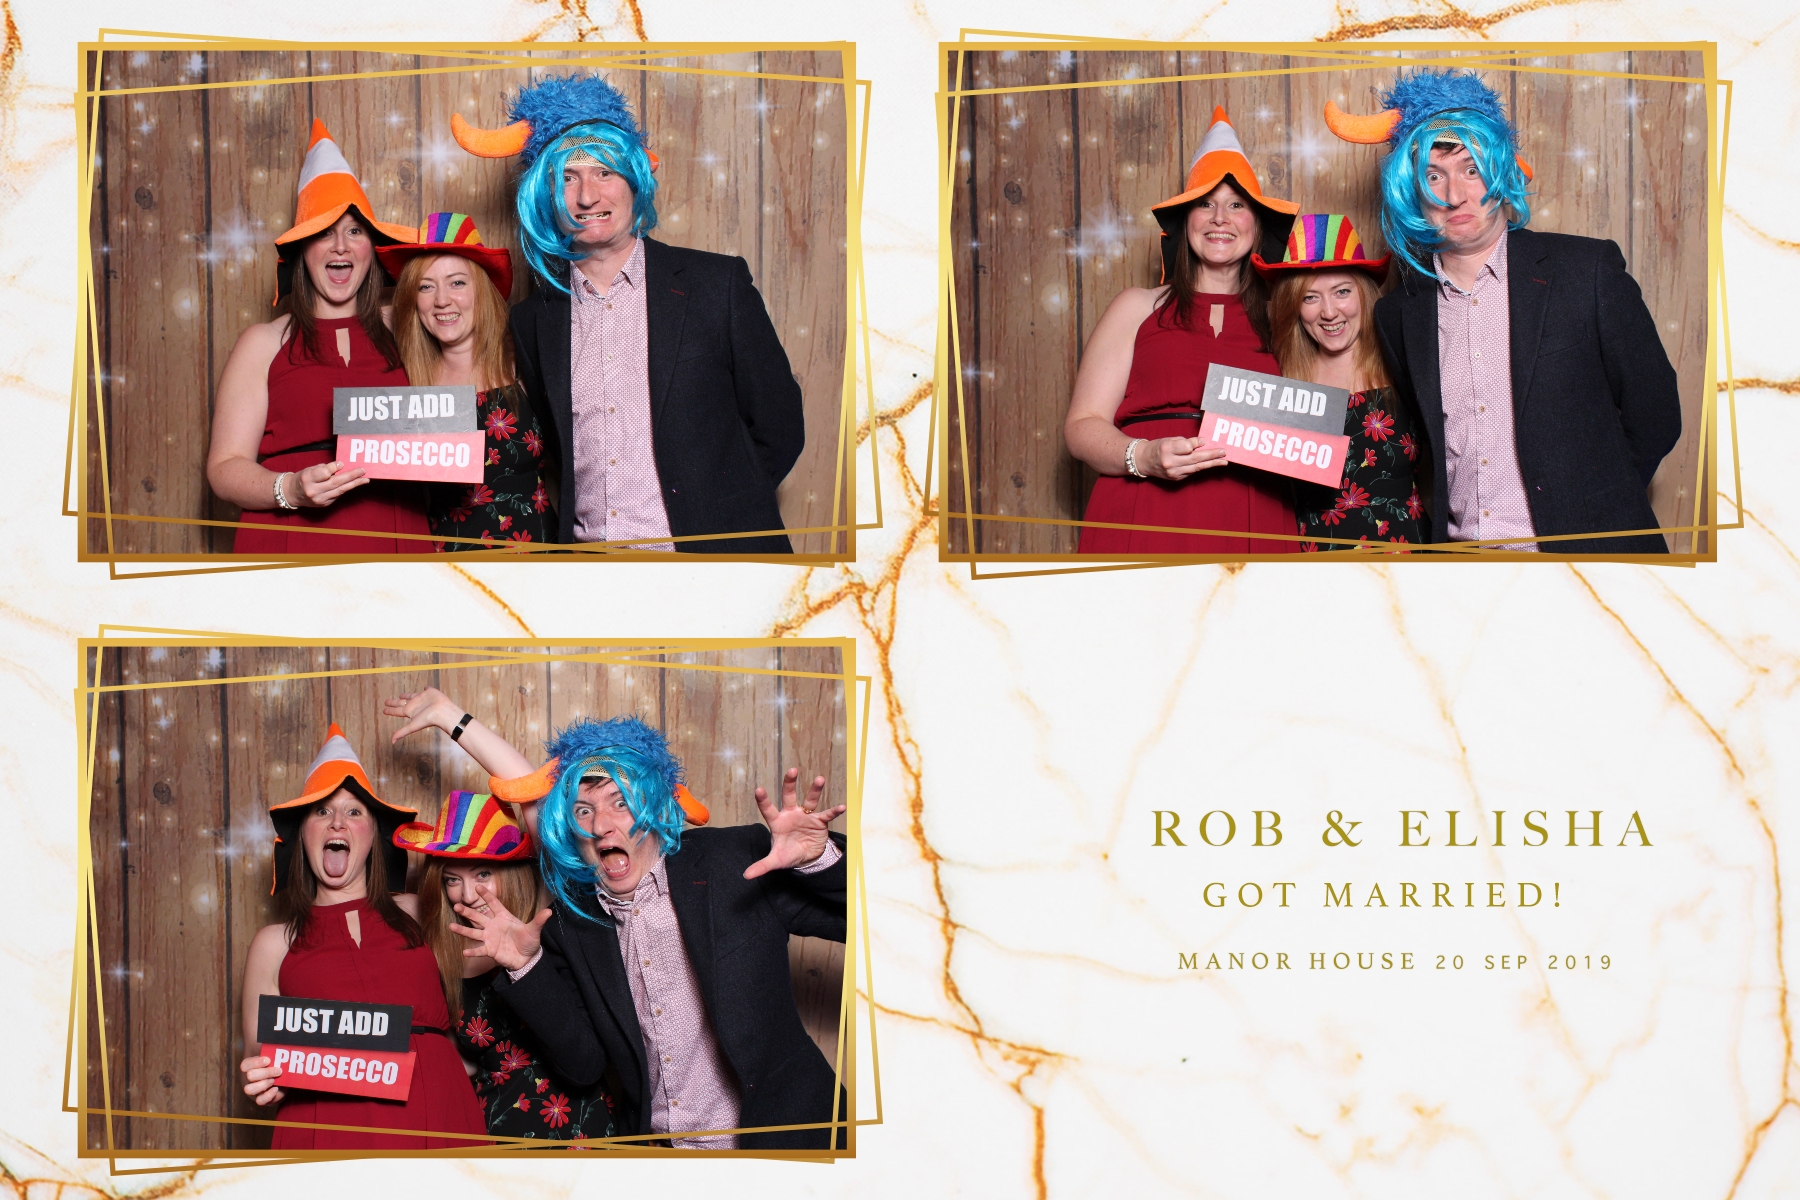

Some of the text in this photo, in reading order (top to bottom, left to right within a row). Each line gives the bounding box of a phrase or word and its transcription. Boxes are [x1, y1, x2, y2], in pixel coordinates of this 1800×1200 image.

[348, 393, 455, 421] JUST ADD
[1218, 376, 1327, 417] JUST ADD
[350, 438, 470, 468] PROSECCO
[1212, 417, 1333, 469] PROSECCO
[274, 1006, 389, 1036] JUST ADD
[274, 1048, 399, 1085] PROSECCO
